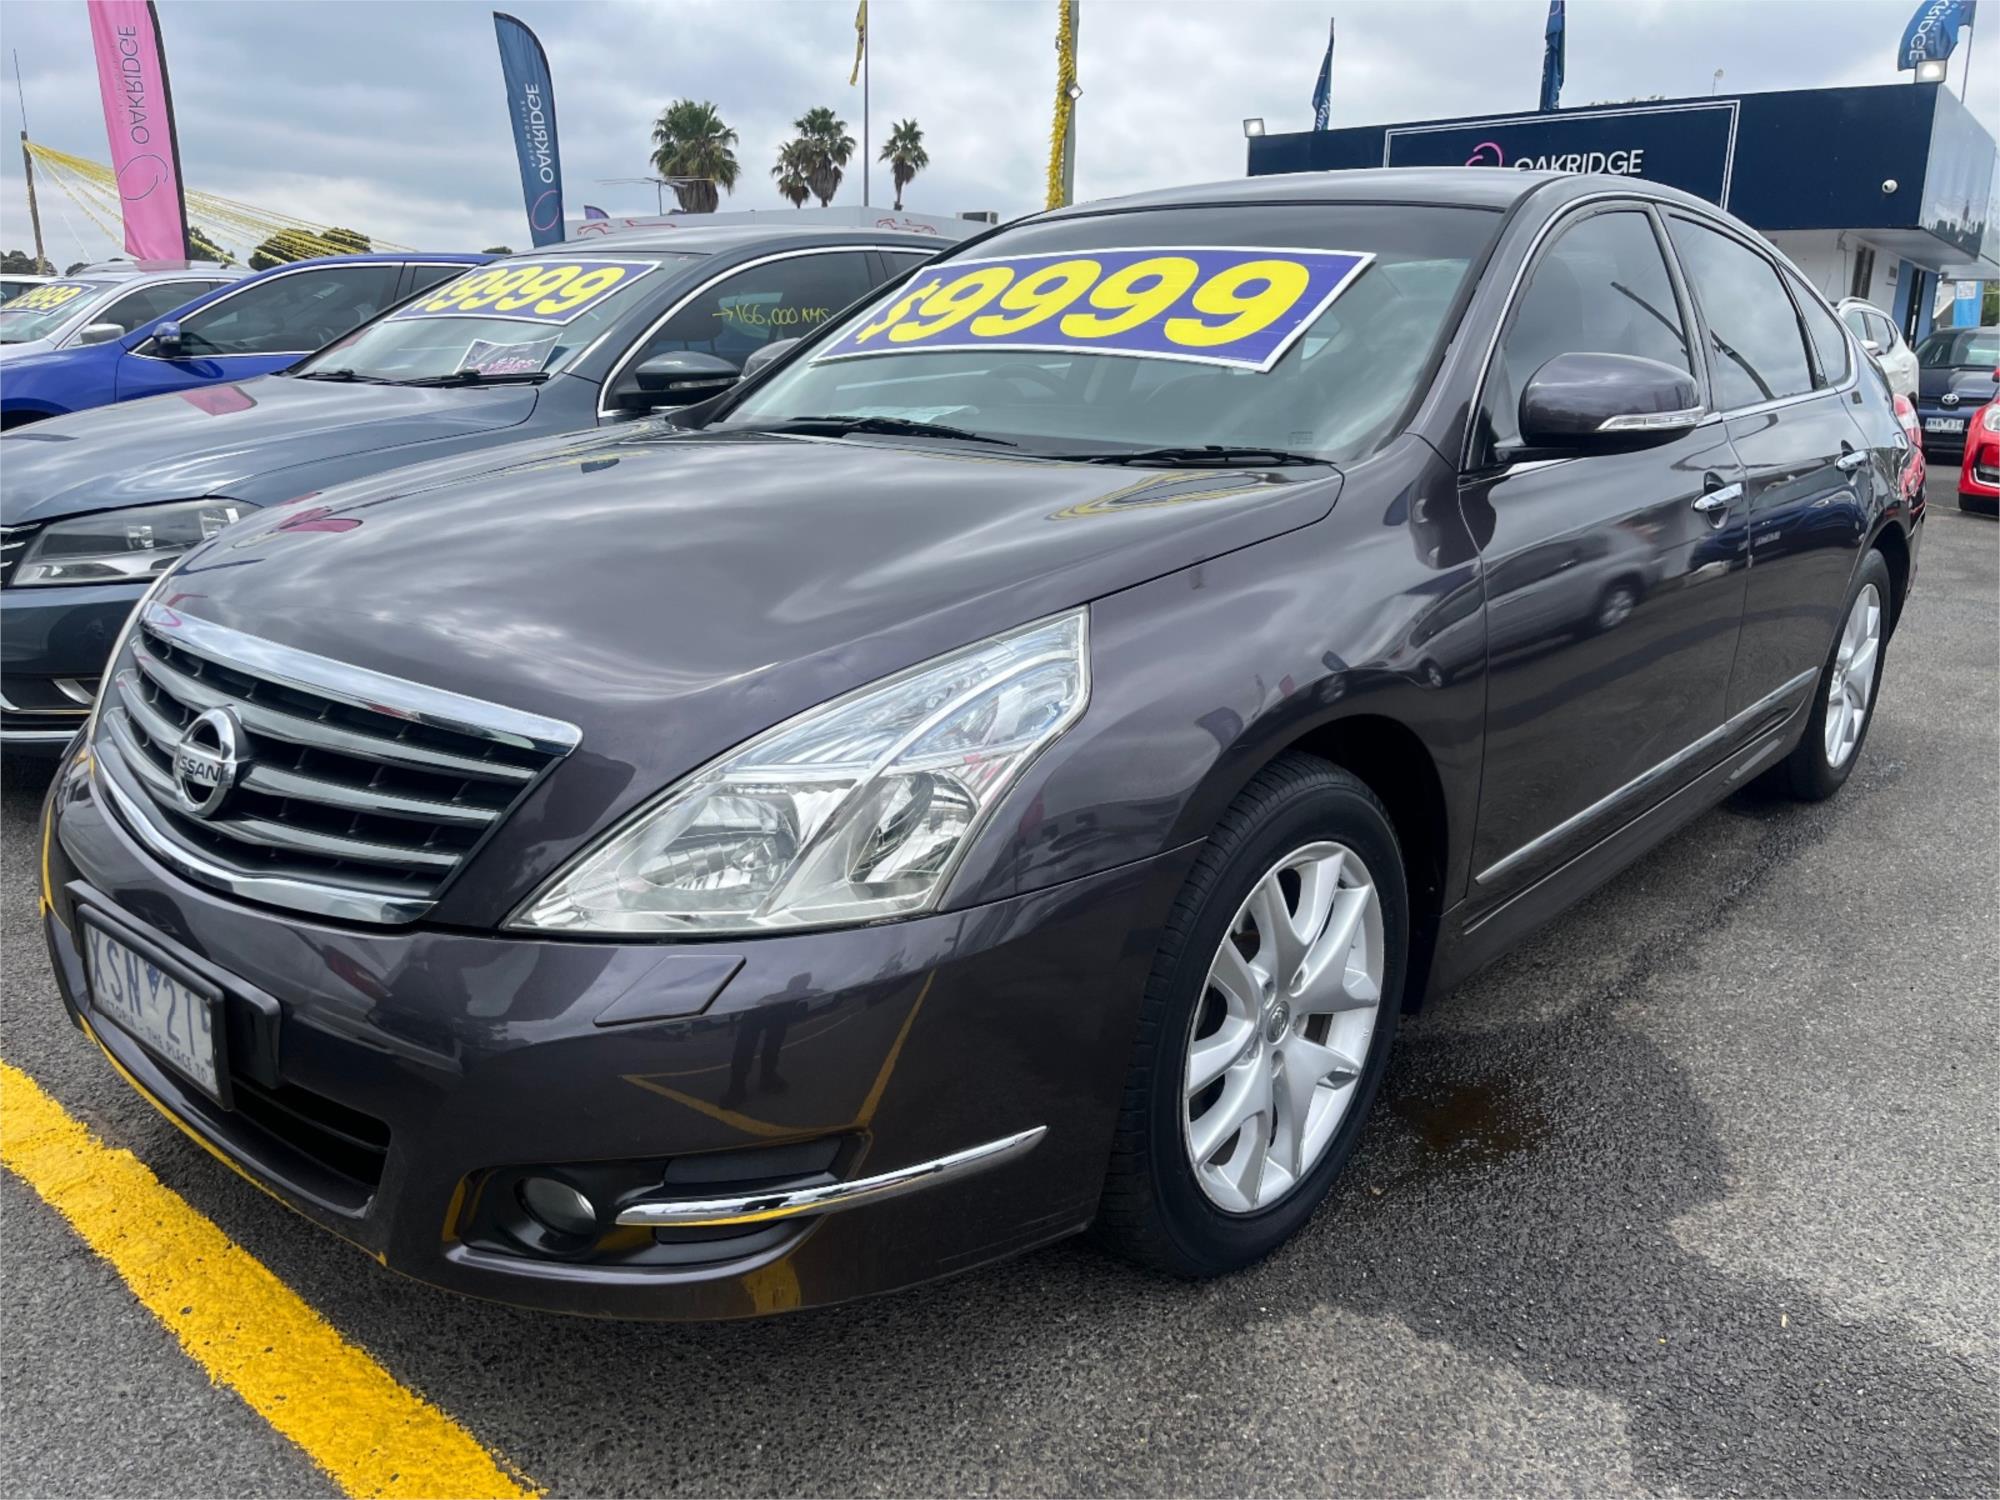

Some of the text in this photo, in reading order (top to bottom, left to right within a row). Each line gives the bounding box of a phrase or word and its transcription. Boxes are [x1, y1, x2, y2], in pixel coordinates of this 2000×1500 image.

[1514, 149, 1644, 175] OAKRIDGE
[411, 265, 626, 315] $9999
[736, 303, 830, 326] 166,000 KMS
[855, 256, 1310, 347] $9999
[89, 926, 142, 1017] XSN
